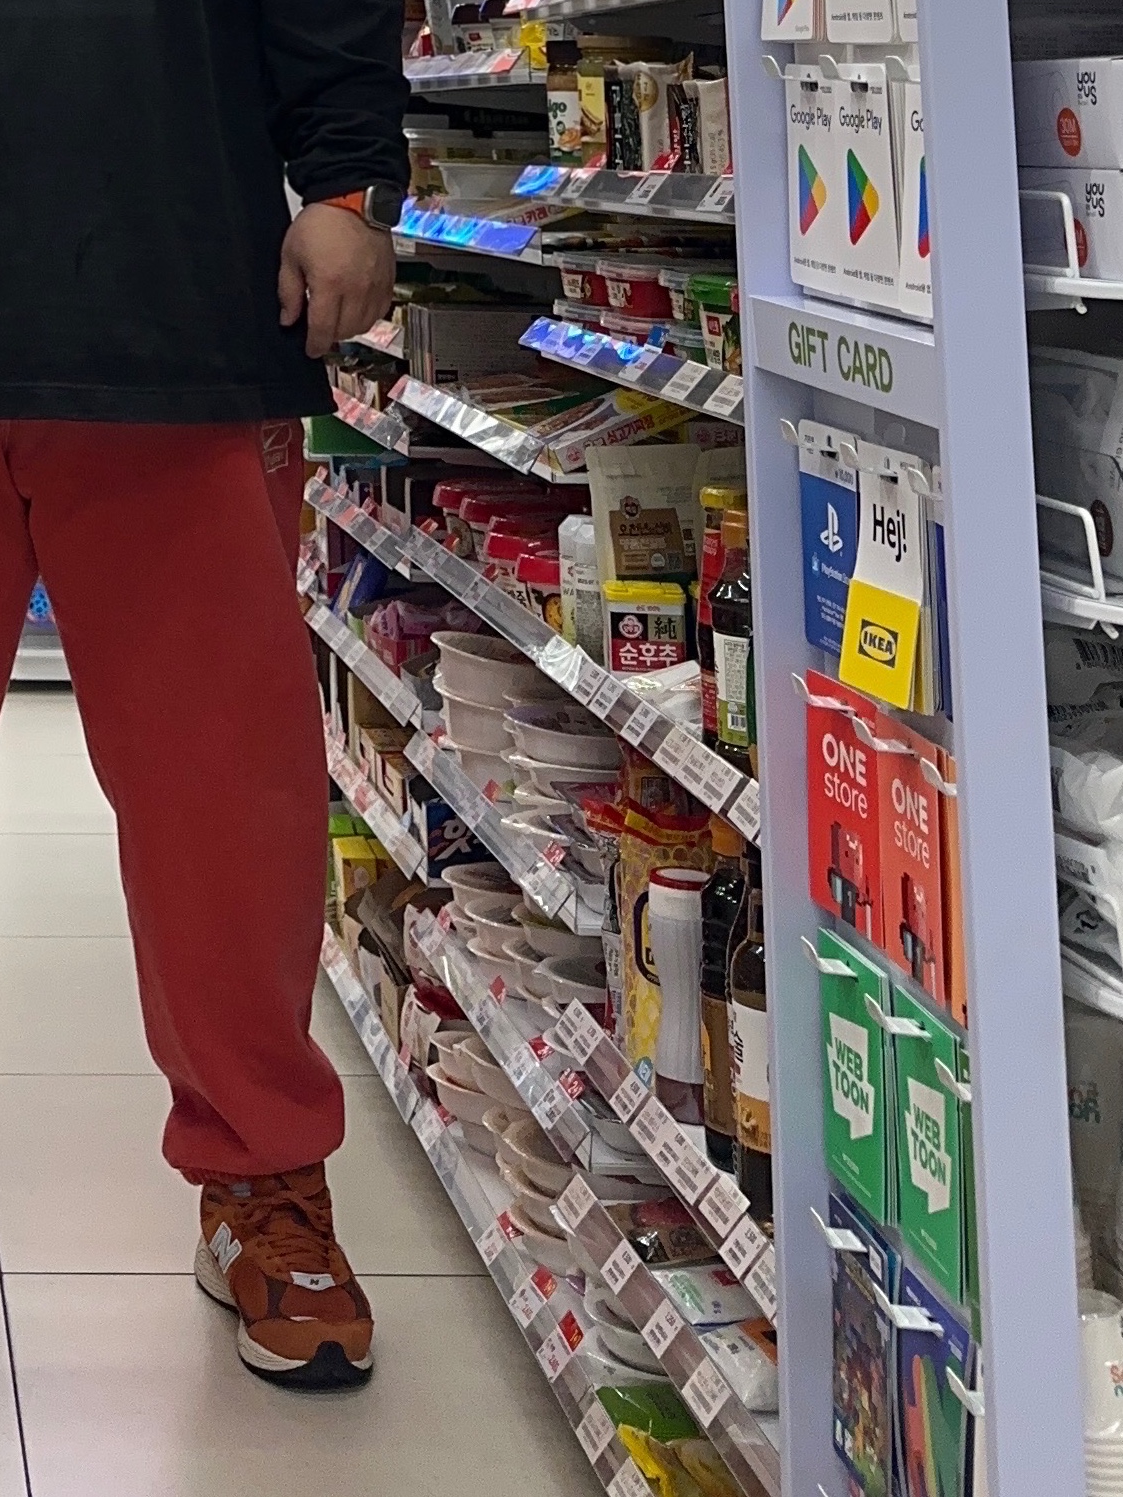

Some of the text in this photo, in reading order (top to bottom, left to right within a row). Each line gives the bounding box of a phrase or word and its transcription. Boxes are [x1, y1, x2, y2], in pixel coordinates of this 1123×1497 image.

[790, 105, 832, 133] Google Play
[839, 106, 865, 134] Google
[866, 109, 882, 135] Play
[788, 321, 894, 394] GIFT CARD
[872, 503, 907, 563] Hej!
[619, 642, 678, 668] 순후추
[863, 629, 894, 656] IKEA
[822, 733, 867, 787] ONE
[823, 771, 868, 820] store
[891, 778, 929, 834] ONE
[893, 819, 930, 869] store
[833, 1037, 864, 1082] WEB
[832, 1070, 871, 1116] TOON
[912, 1102, 941, 1153] WEB
[910, 1130, 947, 1187] TOON
[210, 1221, 242, 1274] N
